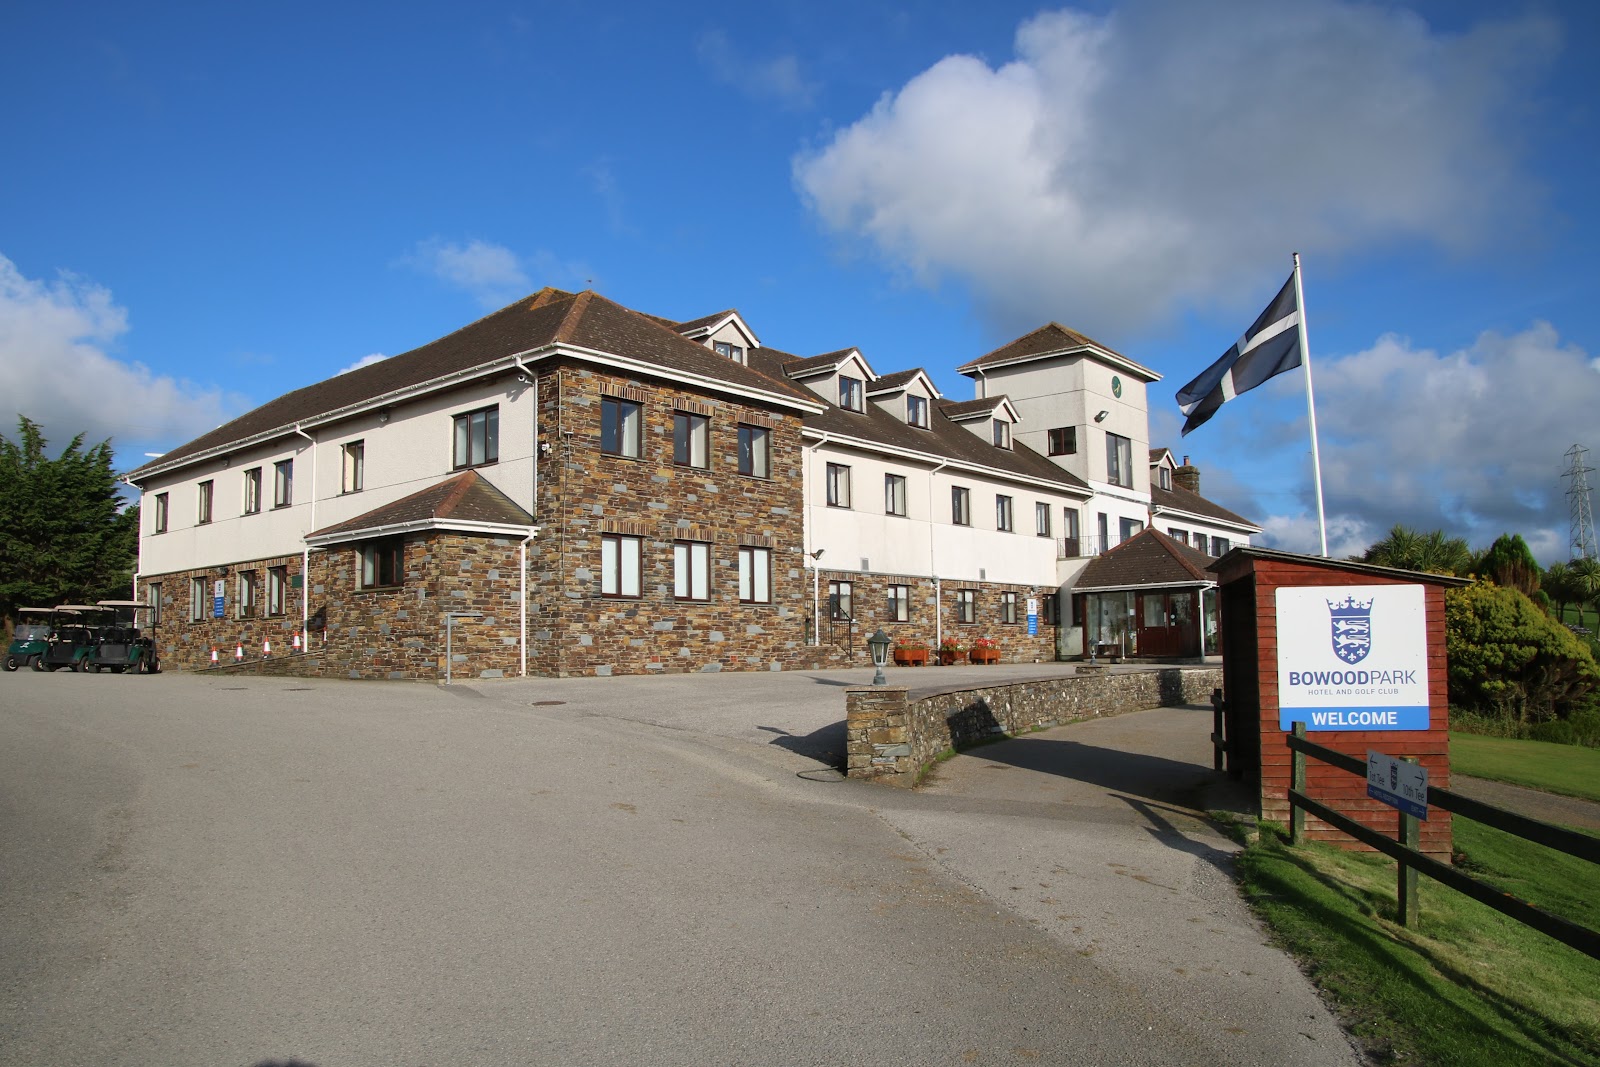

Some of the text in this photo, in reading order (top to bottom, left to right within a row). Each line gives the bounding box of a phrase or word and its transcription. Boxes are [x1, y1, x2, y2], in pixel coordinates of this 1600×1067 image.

[1312, 712, 1397, 725] WELCOME
[1403, 783, 1425, 802] 10th Tee
